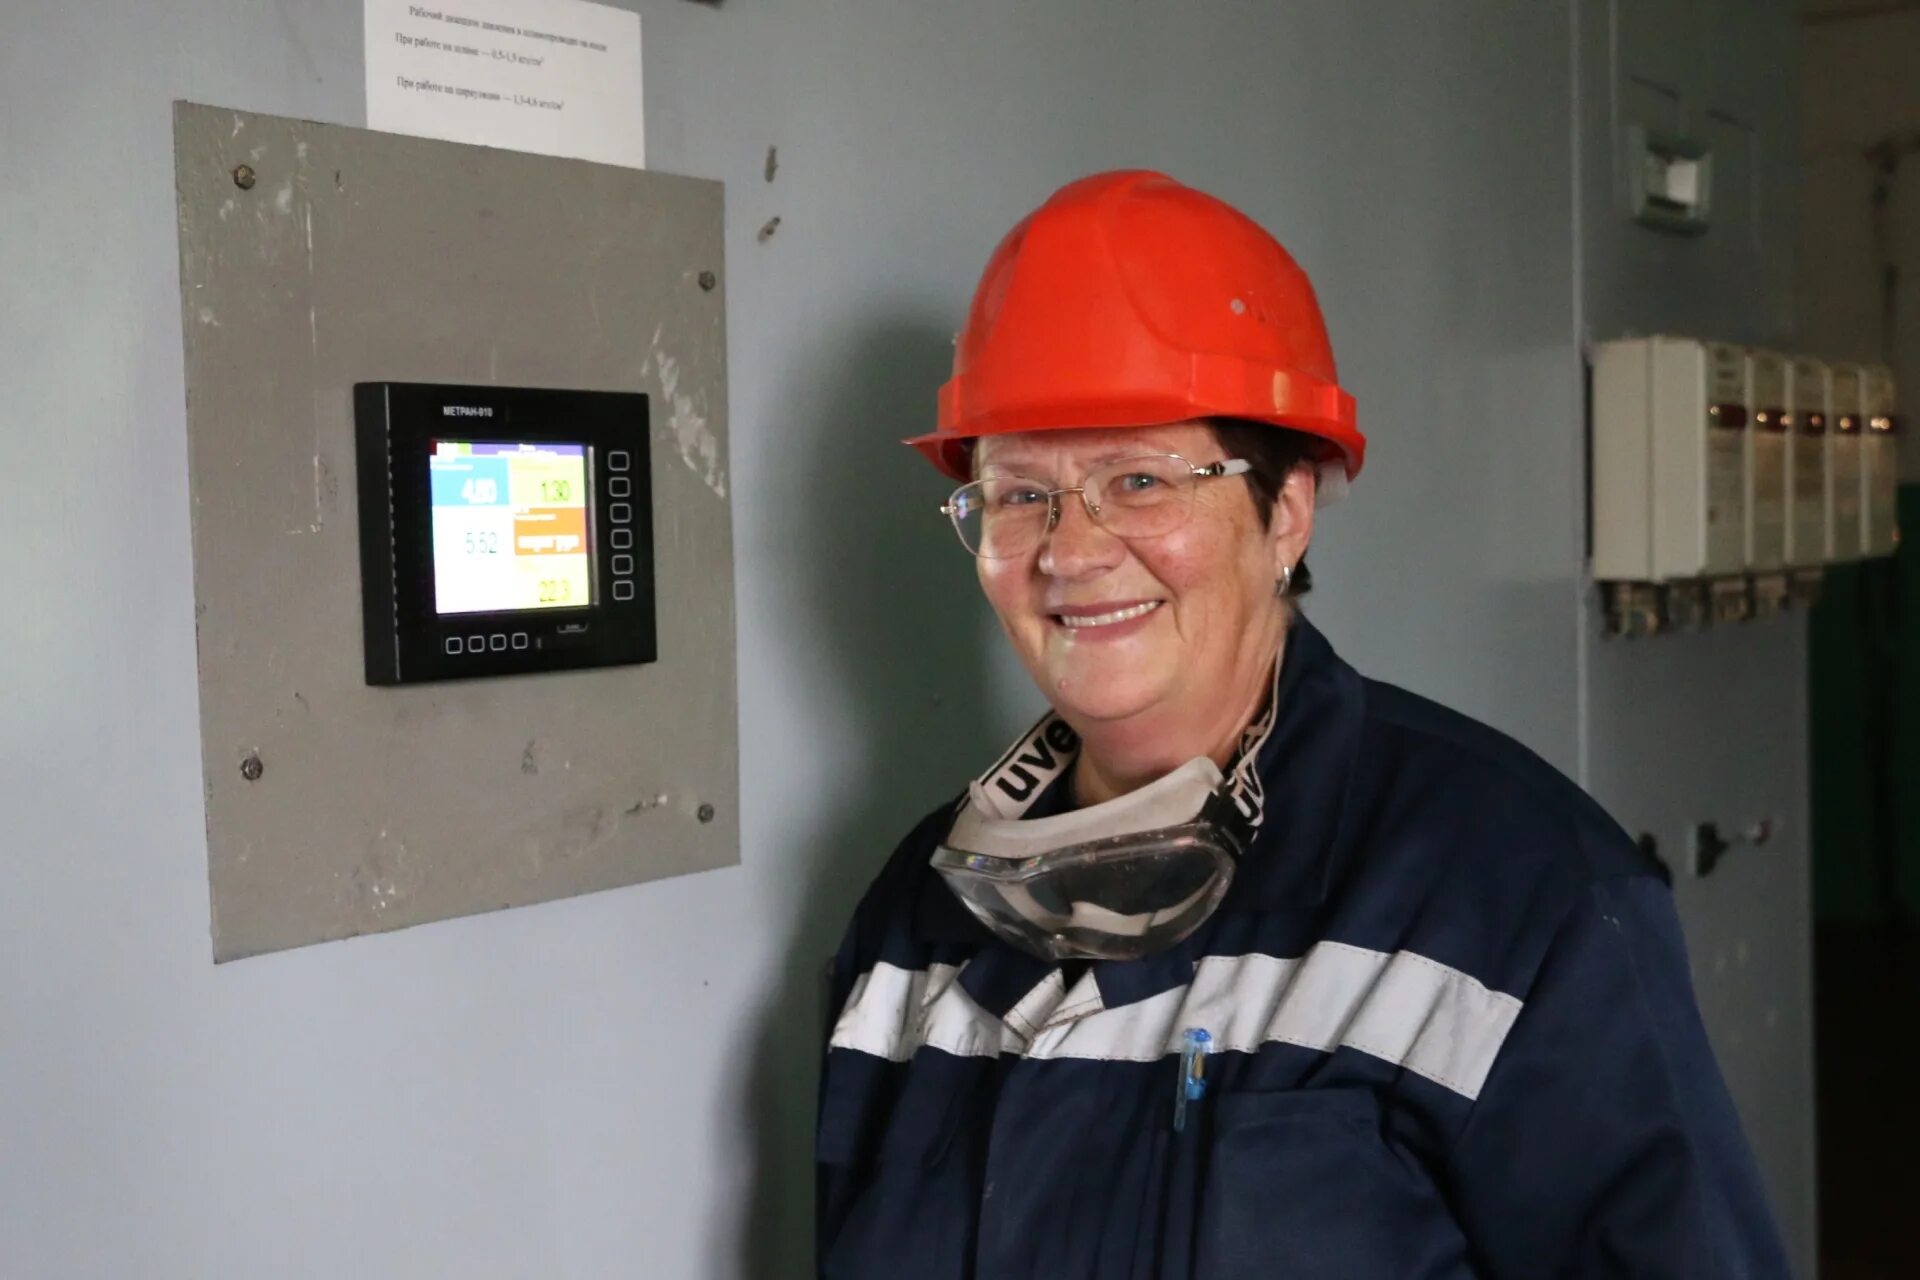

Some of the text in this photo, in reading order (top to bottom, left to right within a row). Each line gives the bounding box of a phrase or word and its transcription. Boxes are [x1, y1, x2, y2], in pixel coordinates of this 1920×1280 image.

[409, 5, 443, 21] Рабочий
[395, 32, 414, 48] При
[414, 36, 441, 51] работе
[396, 75, 414, 91] При
[415, 79, 442, 94] работе
